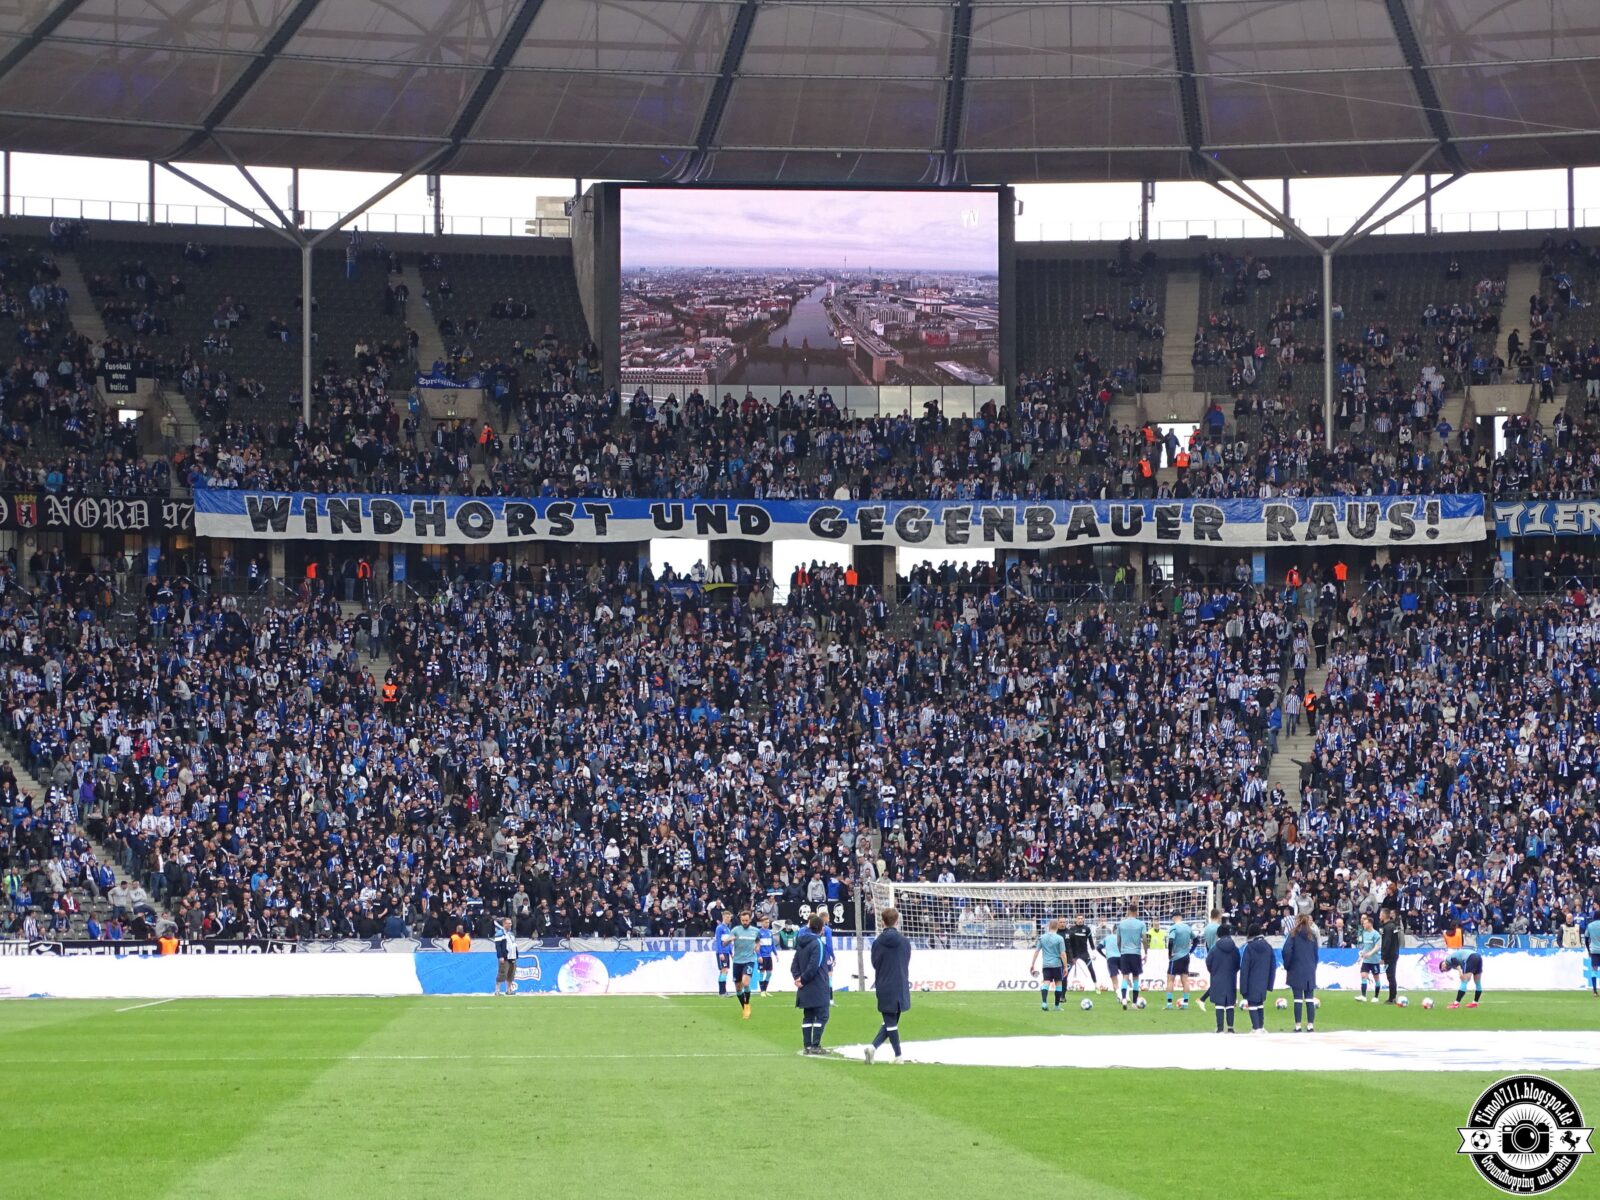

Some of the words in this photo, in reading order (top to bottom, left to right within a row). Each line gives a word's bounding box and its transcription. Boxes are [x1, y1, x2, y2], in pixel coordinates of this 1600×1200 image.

[44, 494, 150, 530] NORD
[244, 494, 613, 540] WINDHORST
[648, 502, 772, 537] UND
[807, 501, 1226, 545] GEGENBAUER
[1260, 499, 1441, 543] RAUS!
